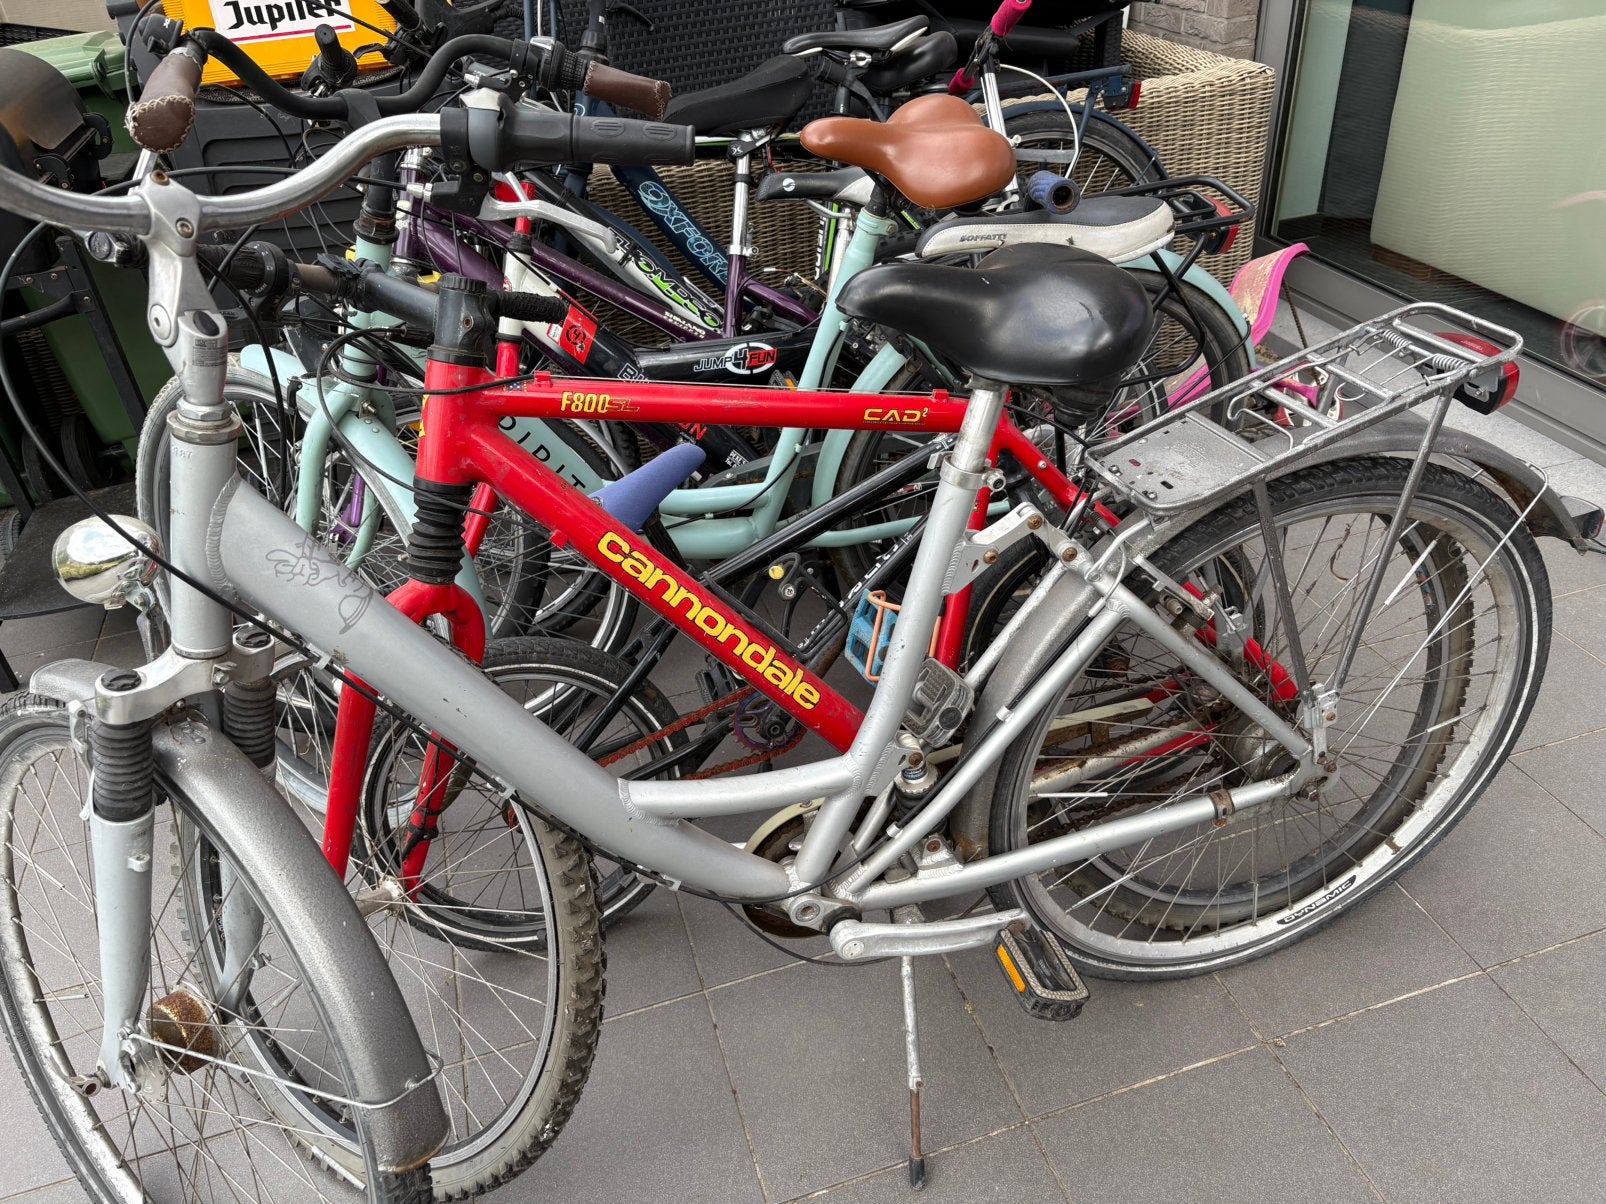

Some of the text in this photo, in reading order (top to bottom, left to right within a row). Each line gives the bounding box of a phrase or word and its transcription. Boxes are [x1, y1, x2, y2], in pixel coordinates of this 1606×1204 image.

[638, 181, 729, 286] OXFOR
[597, 531, 821, 710] cannondale
[1283, 880, 1352, 923] DYNAMIC
